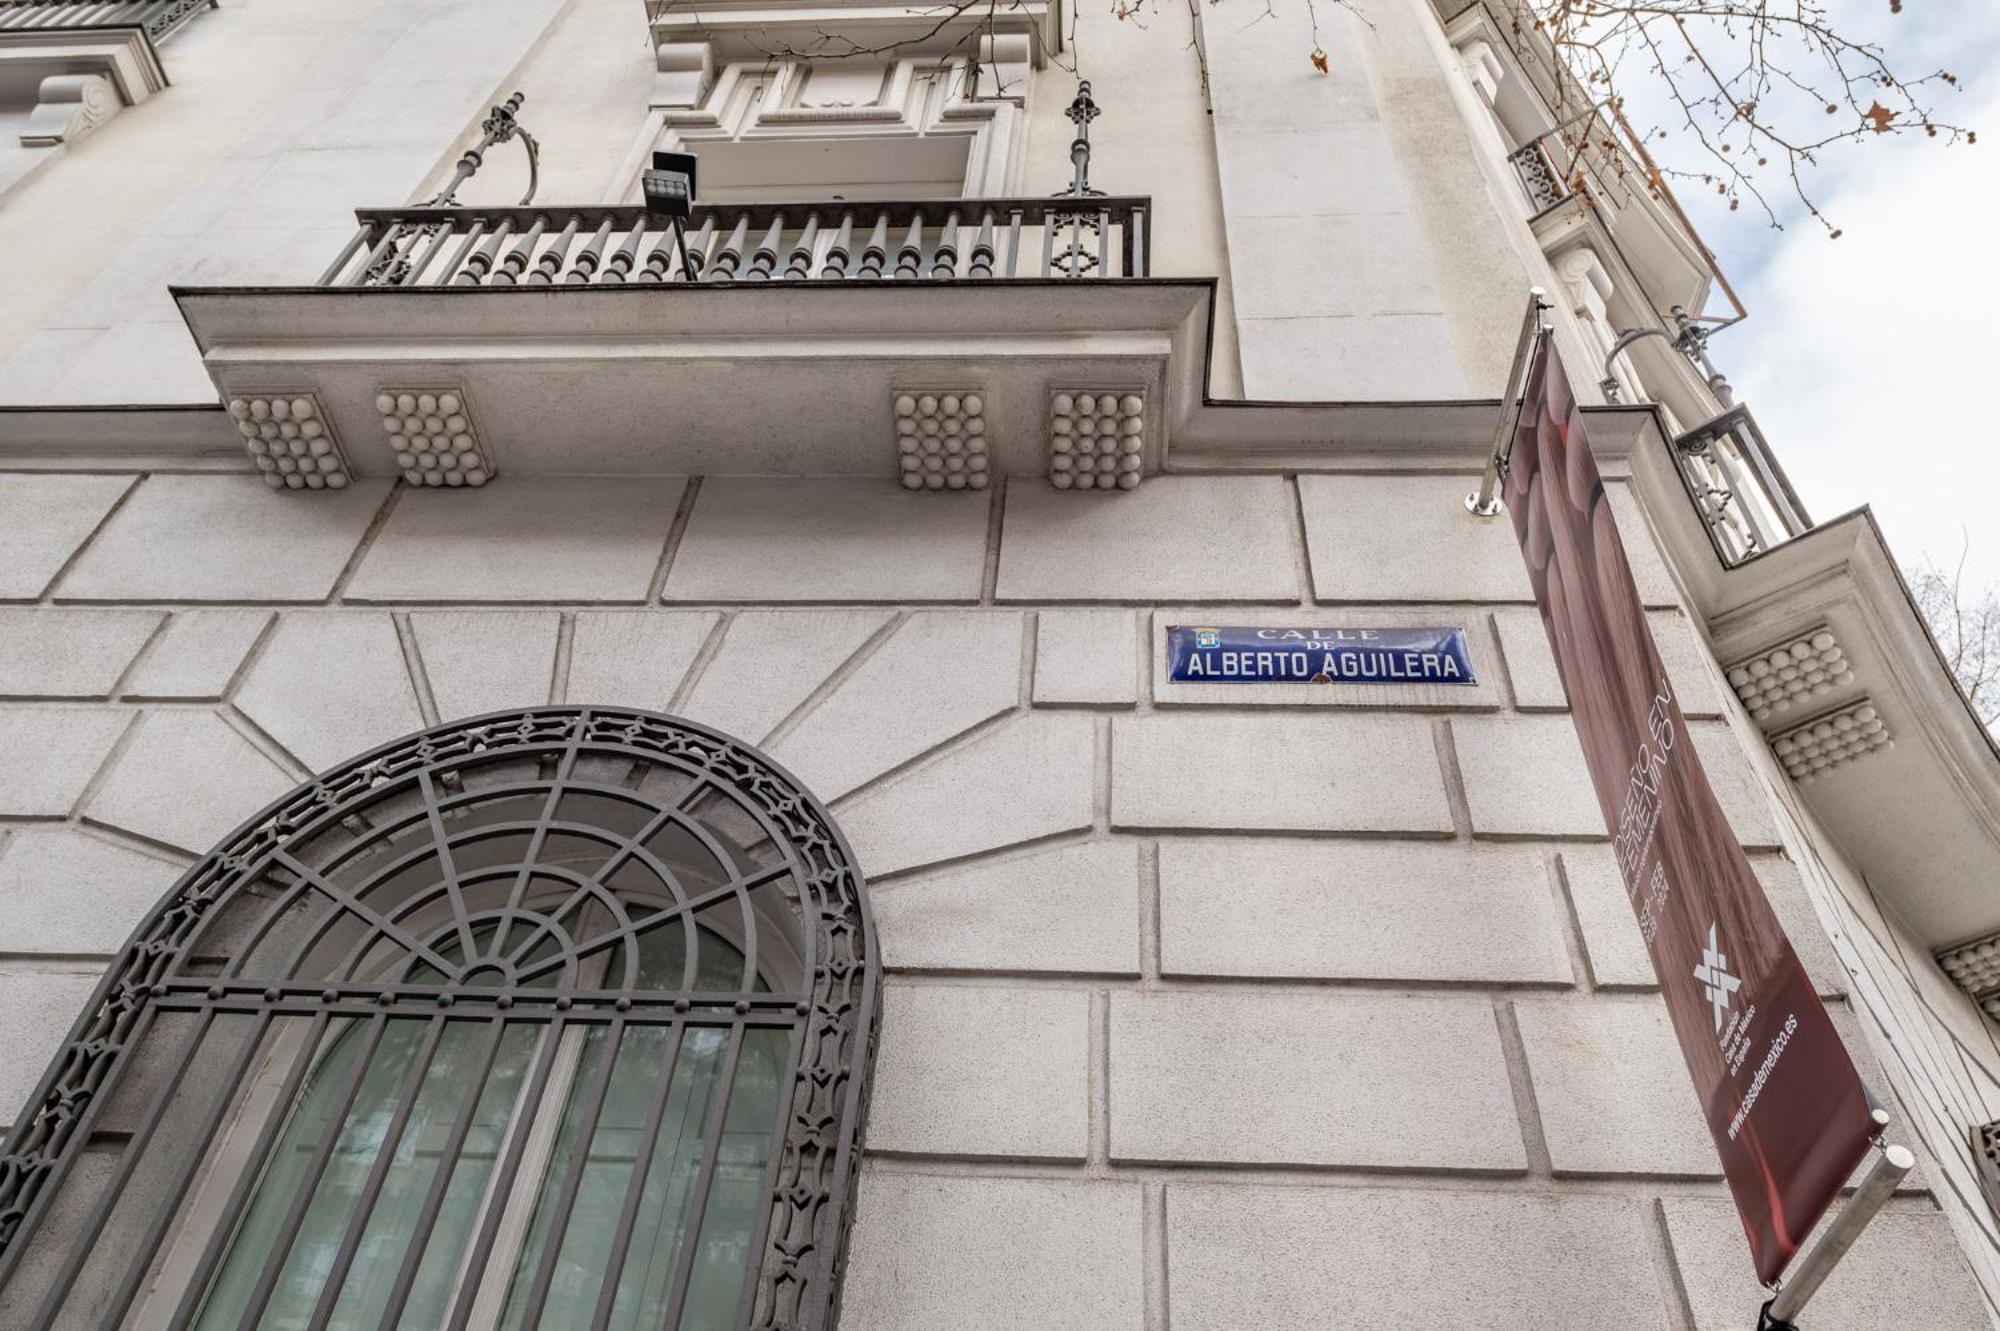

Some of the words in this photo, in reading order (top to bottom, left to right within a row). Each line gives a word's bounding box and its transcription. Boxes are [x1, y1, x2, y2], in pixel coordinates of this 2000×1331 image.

[1187, 652, 1308, 676] ALBERTO
[1321, 652, 1461, 677] AGUILERA
[1257, 629, 1380, 640] CALLE
[1306, 640, 1335, 650] DE
[1614, 743, 1650, 866] DISEÑO
[1648, 678, 1671, 741] EN
[1622, 718, 1674, 889] FEMENINO
[1727, 1013, 1798, 1141] www.casademexico.es
